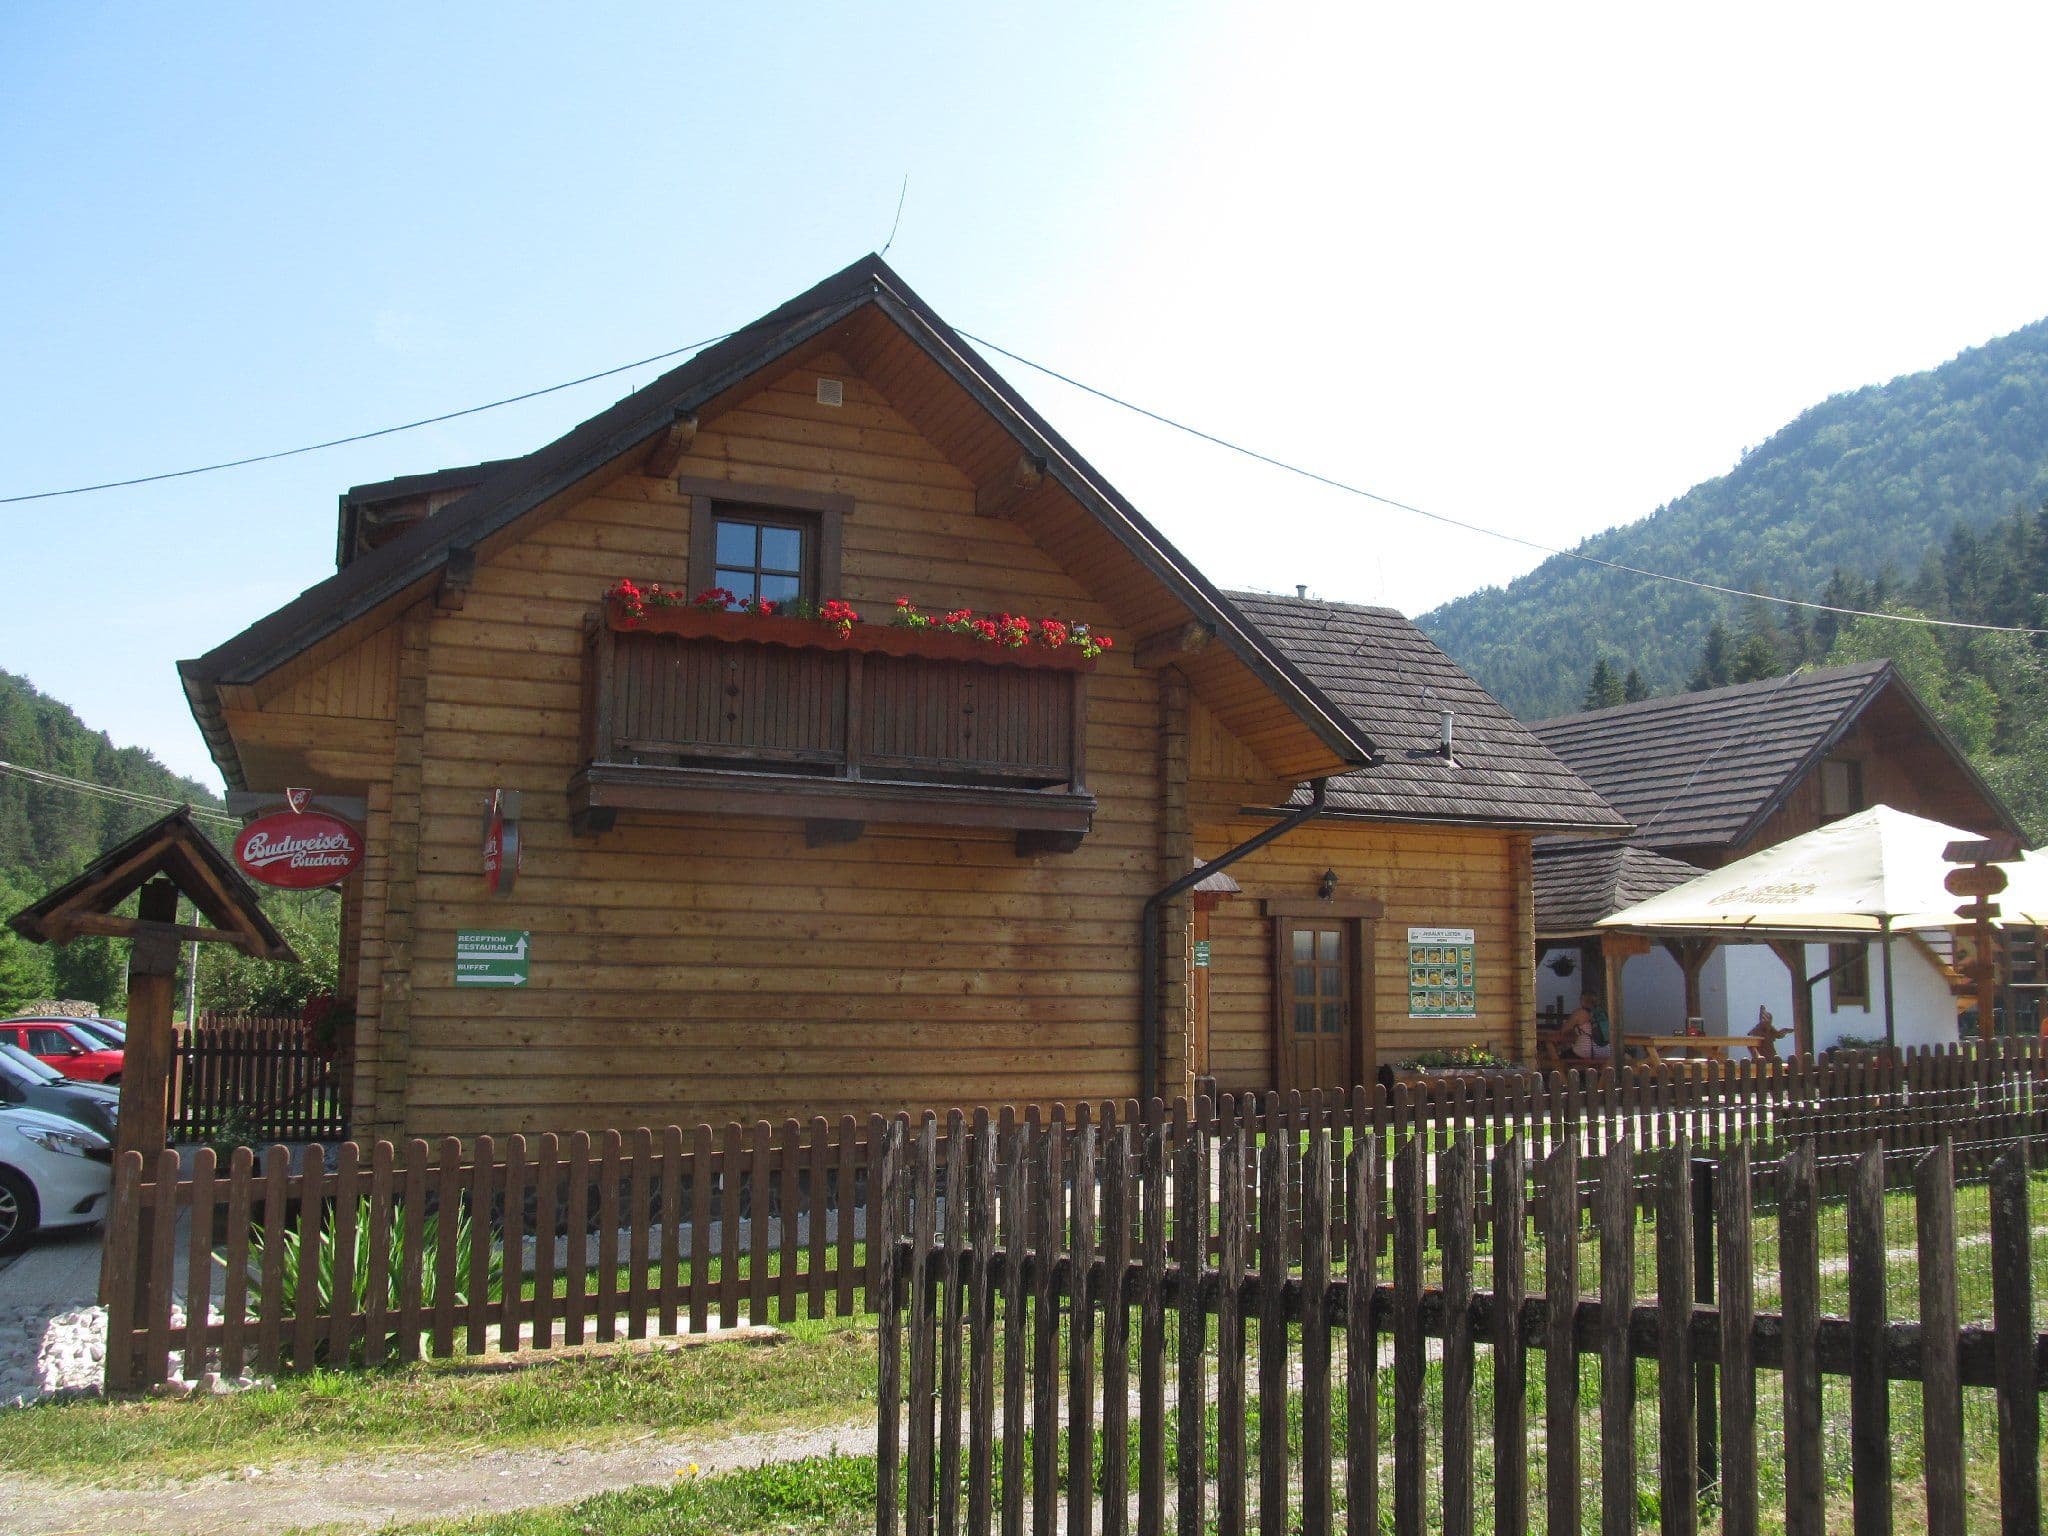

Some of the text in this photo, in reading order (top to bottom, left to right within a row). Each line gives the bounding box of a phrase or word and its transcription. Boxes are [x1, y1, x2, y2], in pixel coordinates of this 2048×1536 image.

[243, 832, 355, 862] Budweiser
[290, 850, 351, 868] Budvar
[457, 943, 514, 951] RESTAURANT
